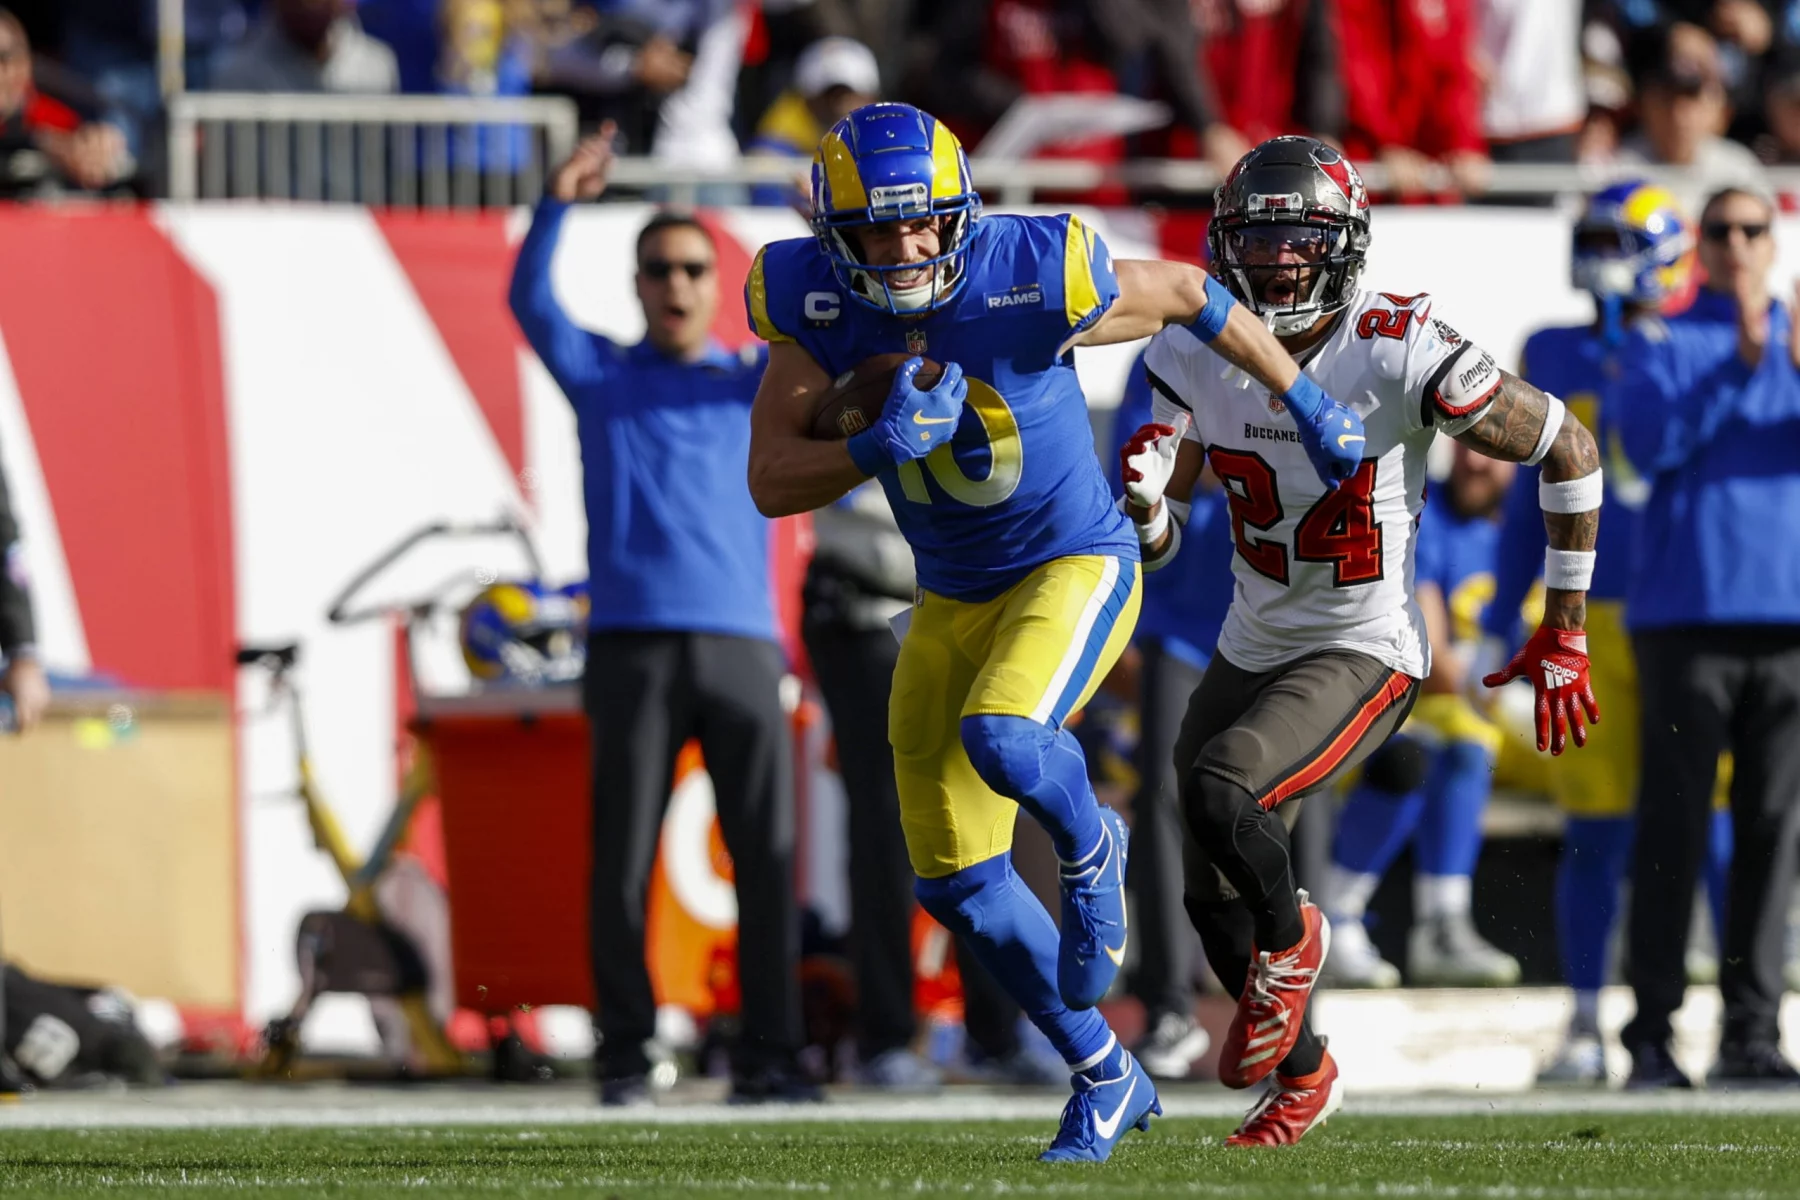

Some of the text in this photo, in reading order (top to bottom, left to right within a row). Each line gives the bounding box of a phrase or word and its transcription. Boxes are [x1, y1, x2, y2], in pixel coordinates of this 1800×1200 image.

[884, 188, 913, 197] RAMS
[804, 291, 841, 320] C
[987, 292, 1041, 309] RAMS
[1244, 422, 1303, 444] BUCCANEE
[1206, 443, 1384, 588] 24
[1540, 659, 1579, 680] adidas
